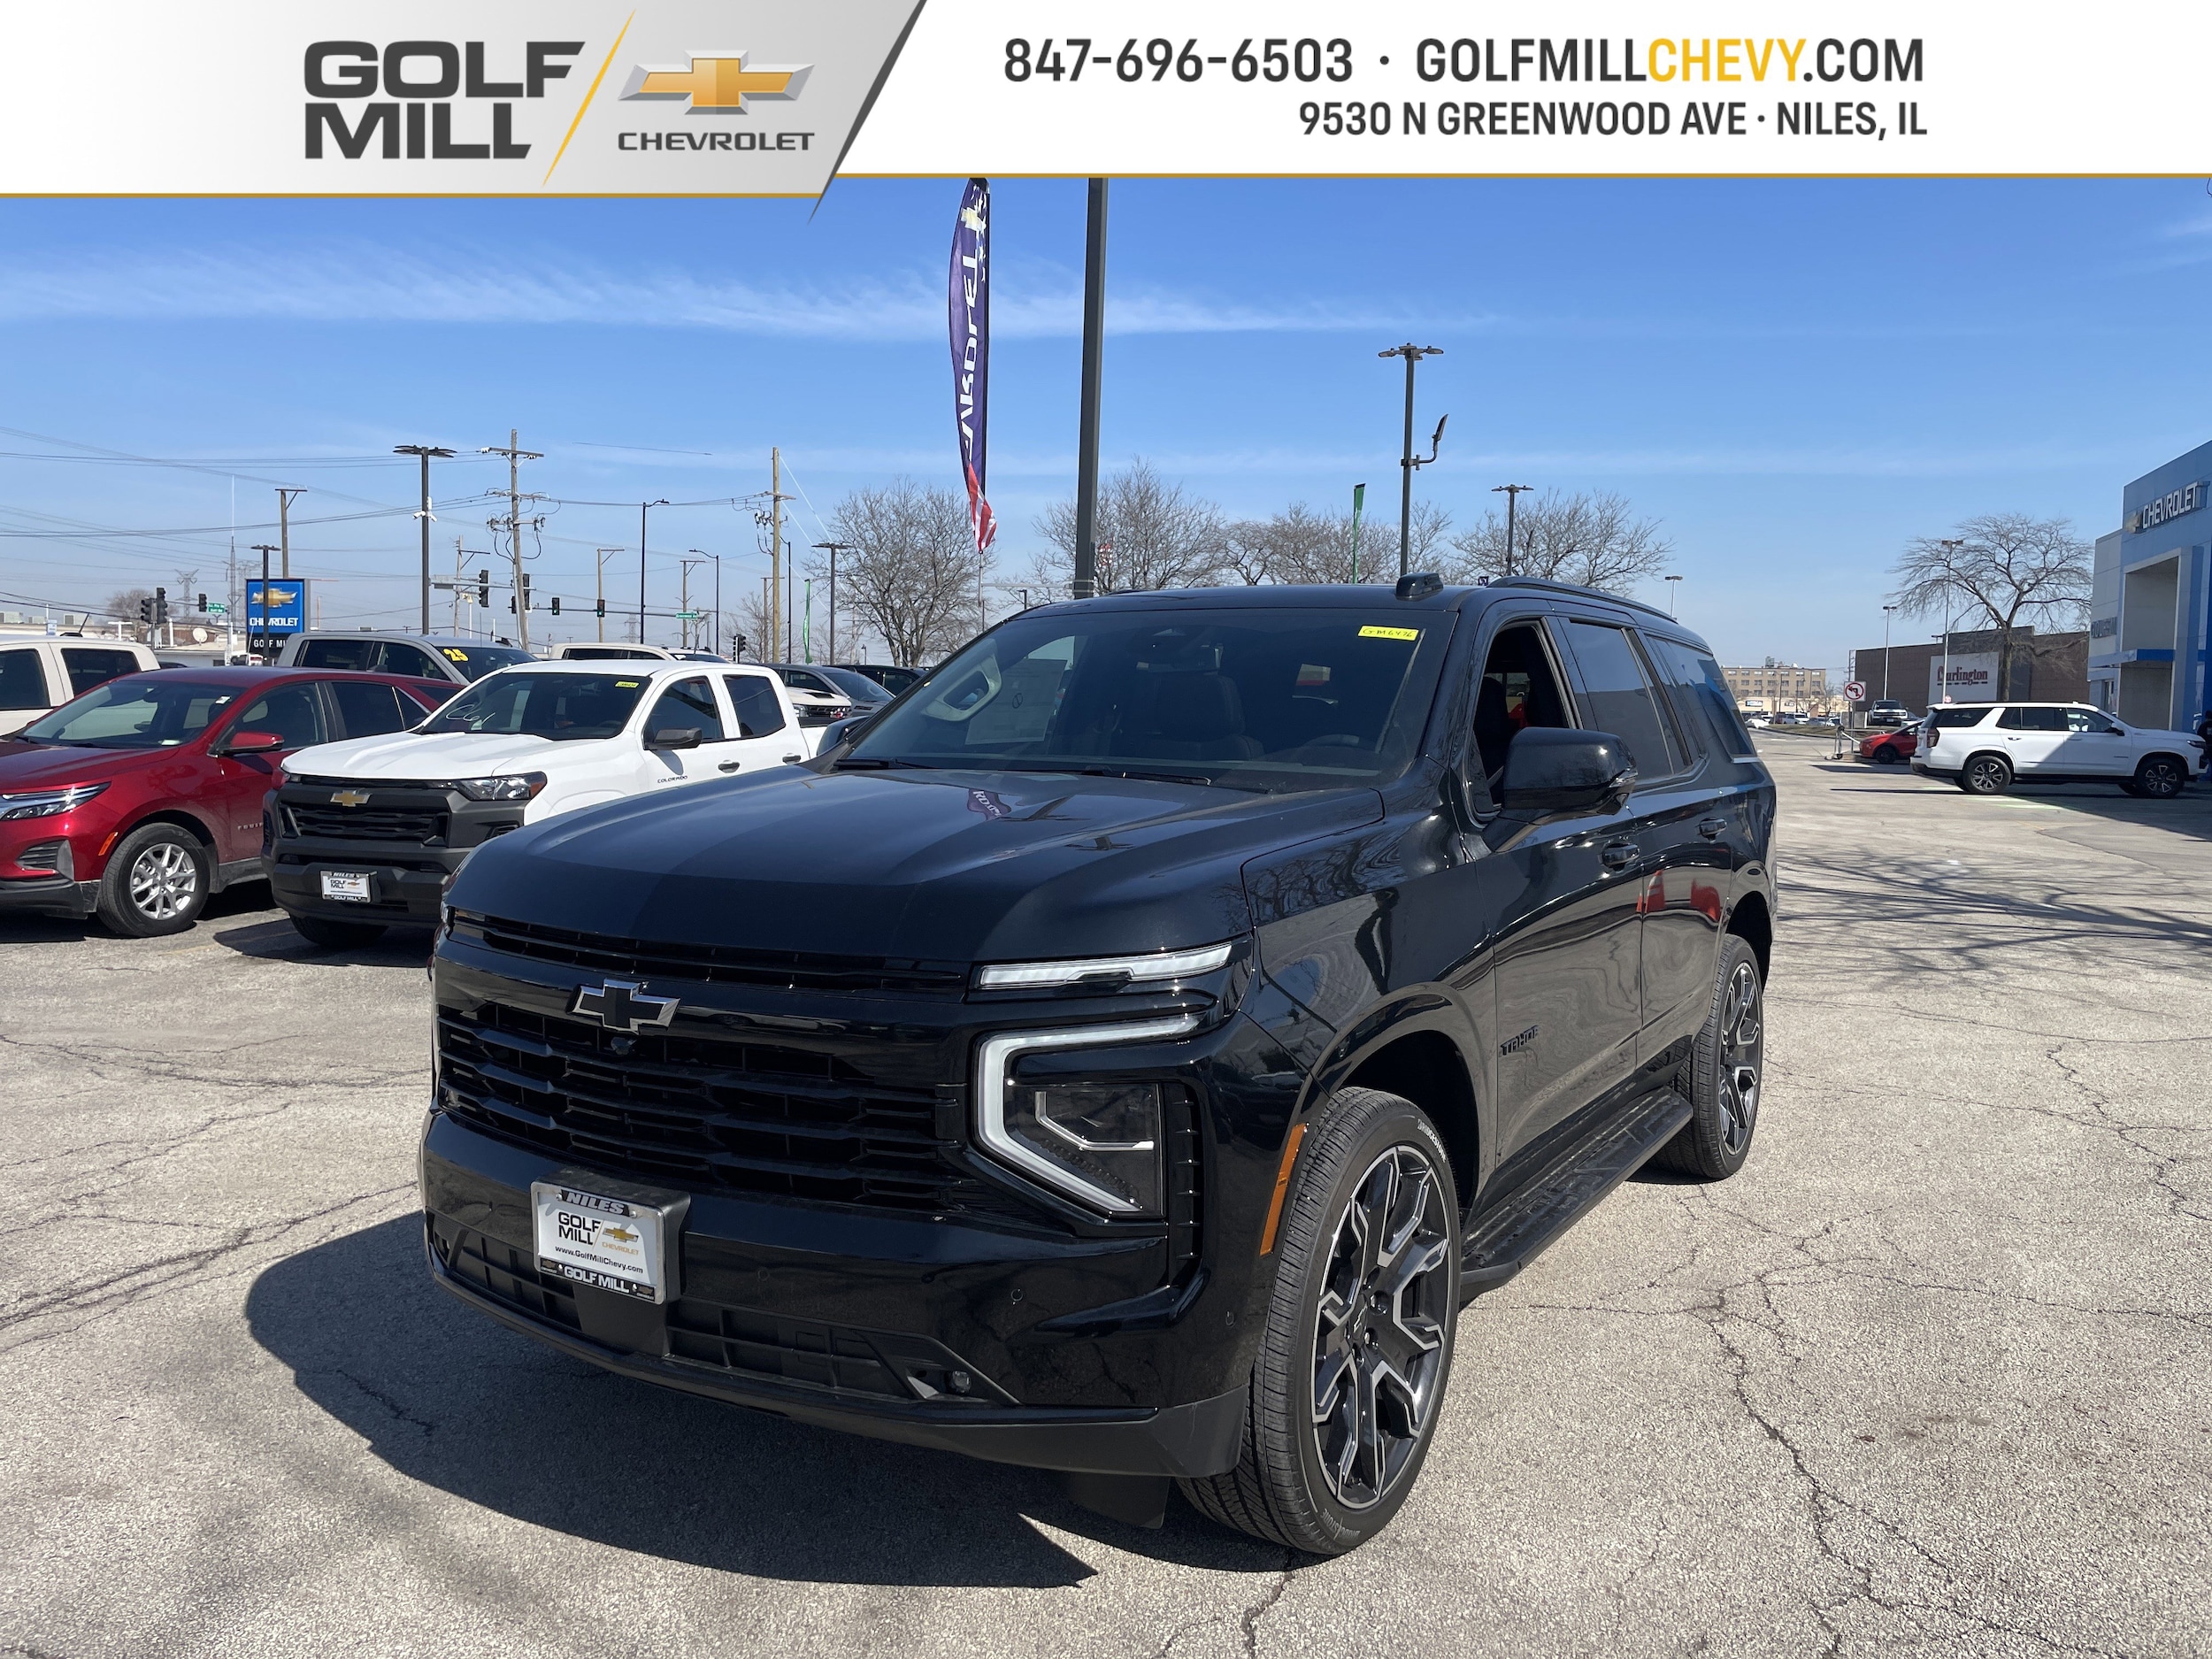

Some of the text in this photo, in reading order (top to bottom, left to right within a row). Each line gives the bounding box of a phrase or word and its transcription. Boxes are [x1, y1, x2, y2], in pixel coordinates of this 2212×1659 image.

[2142, 482, 2198, 529] CHEVROLET
[254, 639, 273, 648] GOF
[566, 1193, 625, 1215] NILES
[558, 1211, 602, 1233] GOLF
[558, 1225, 594, 1246] MILL
[602, 1241, 640, 1256] CHEVROLET
[555, 1246, 643, 1274] www.GolfMillChevy.com
[564, 1265, 630, 1294] GOLF MILL
